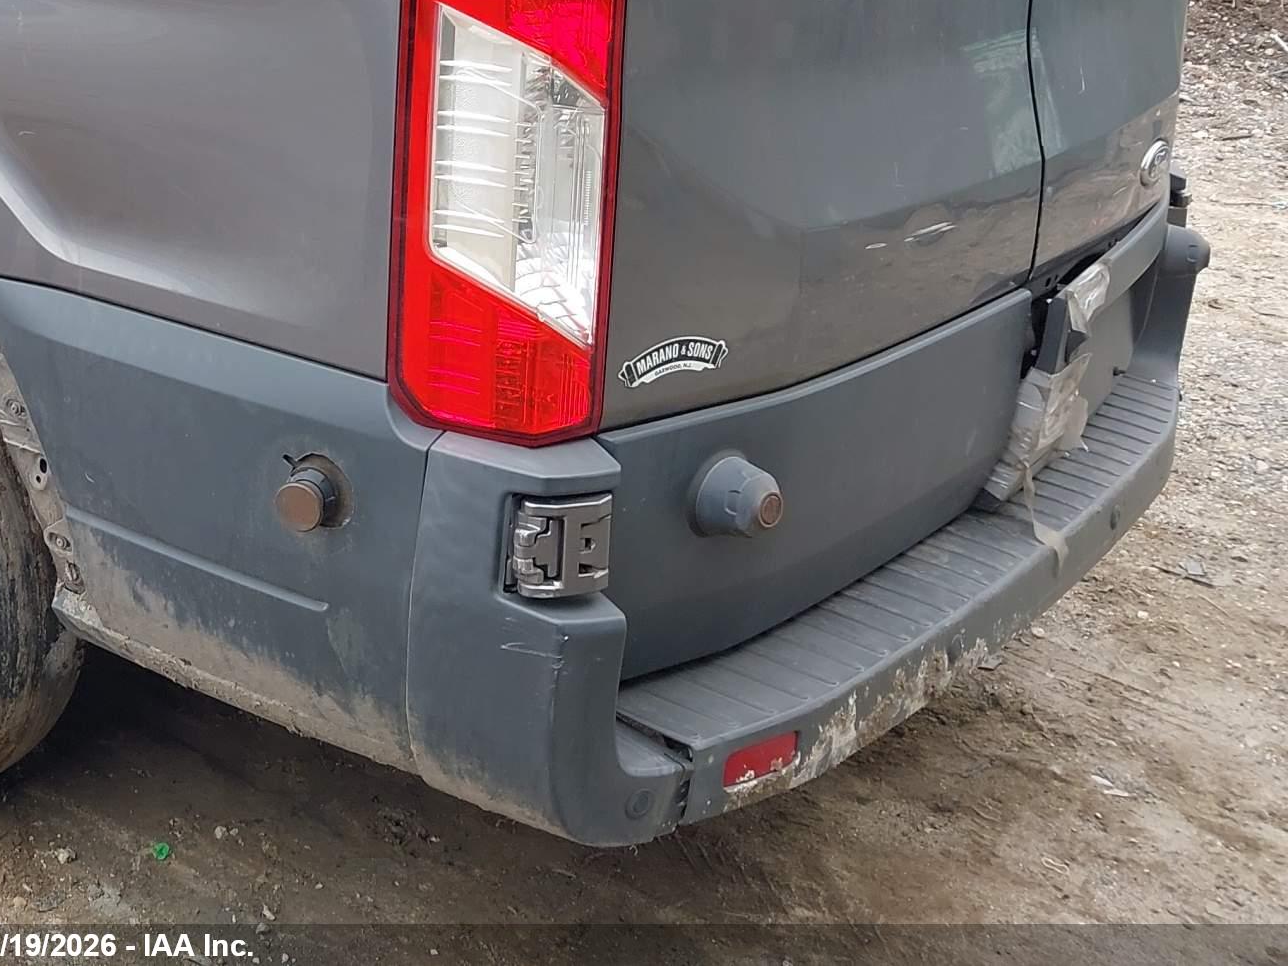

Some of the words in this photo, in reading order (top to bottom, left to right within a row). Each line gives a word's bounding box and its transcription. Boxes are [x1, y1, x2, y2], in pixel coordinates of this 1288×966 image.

[636, 343, 679, 375] MARANO
[680, 345, 687, 355] &
[687, 341, 713, 360] SONS
